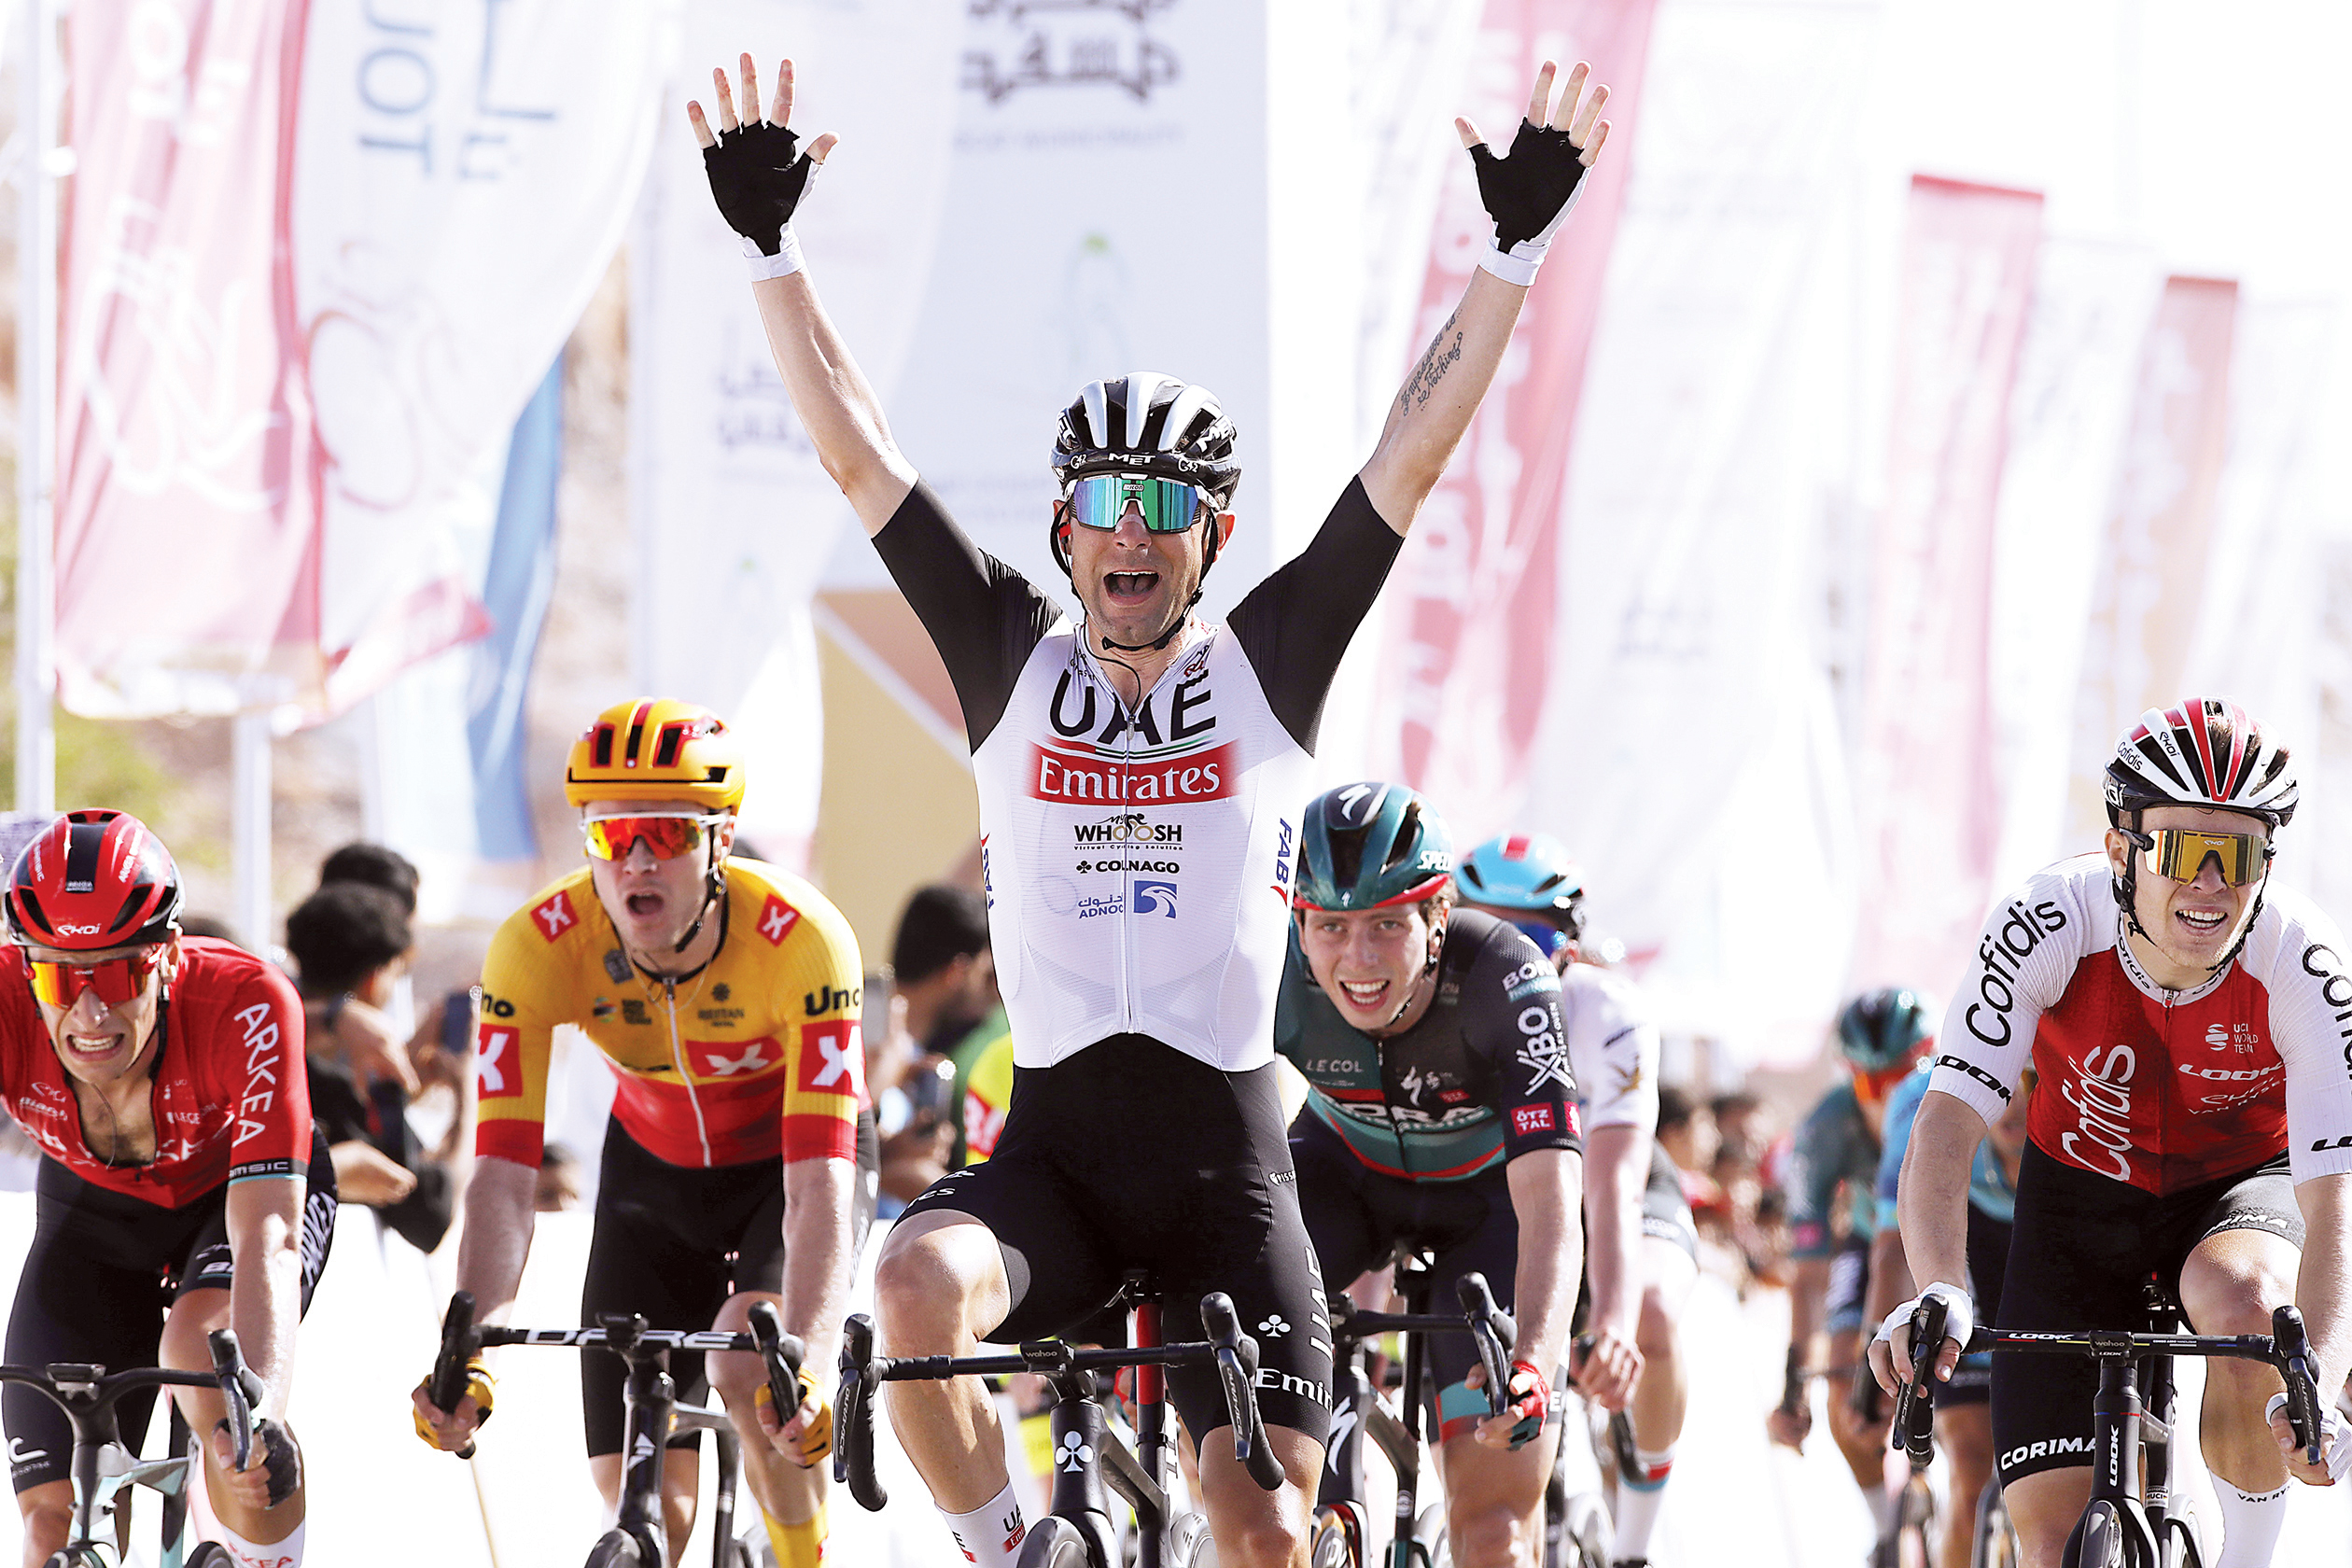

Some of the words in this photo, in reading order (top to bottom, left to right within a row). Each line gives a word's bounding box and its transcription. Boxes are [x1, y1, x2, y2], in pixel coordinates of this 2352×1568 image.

[1108, 453, 1155, 466] MET
[1050, 667, 1216, 746] UAE
[2117, 740, 2143, 771] Cofidis
[1039, 754, 1221, 800] Emirates
[1073, 825, 1183, 842] WHOOSH
[1276, 818, 1292, 885] FAB
[1095, 861, 1180, 874] COLNAGO
[1965, 900, 2067, 1048] Cofidis
[2233, 1023, 2248, 1032] UCI
[1306, 1058, 1328, 1072] LE
[1330, 1058, 1364, 1073] COL
[231, 1002, 279, 1149] ARKEA
[1518, 1119, 1551, 1131] TAL
[2094, 1340, 2125, 1349] wahoo
[1026, 1350, 1057, 1358] wahoo
[2109, 1424, 2120, 1487] LOOK
